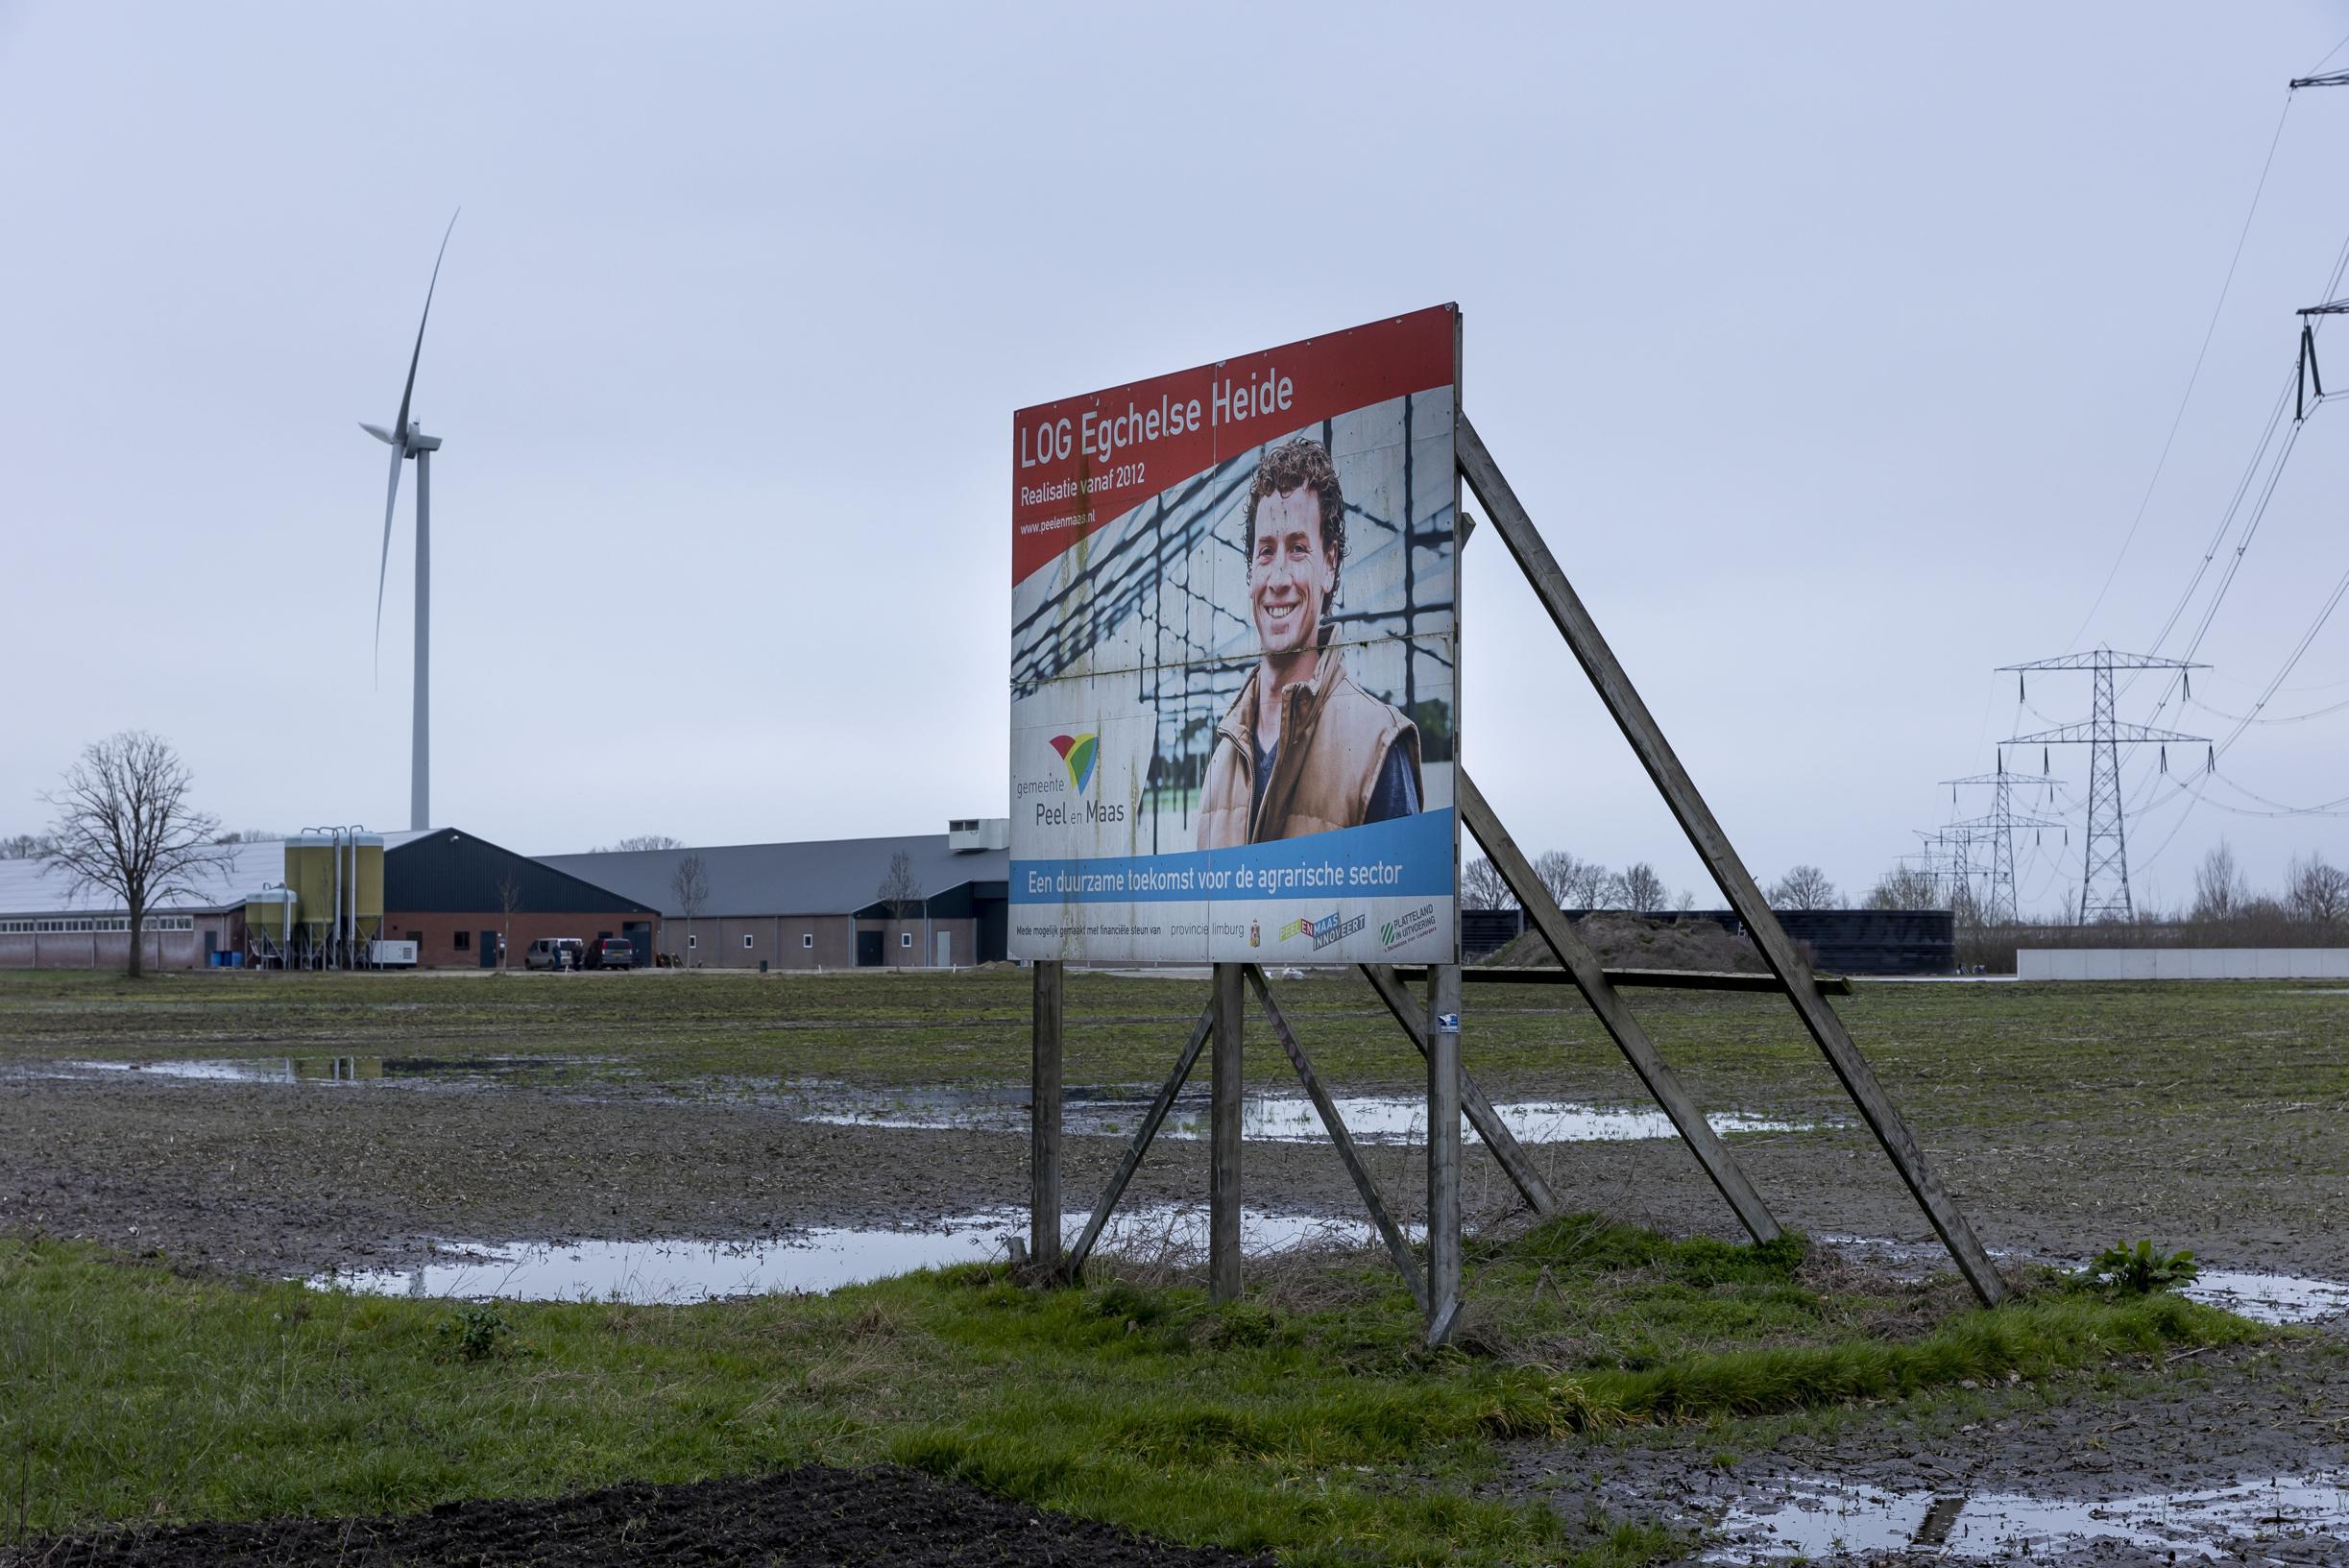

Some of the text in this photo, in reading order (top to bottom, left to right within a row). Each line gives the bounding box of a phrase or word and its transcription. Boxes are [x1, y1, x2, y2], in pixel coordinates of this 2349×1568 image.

[1022, 368, 1294, 469] LOG Egchelse Heide
[1021, 462, 1146, 507] Realisatie vanaf 2012
[1020, 509, 1096, 535] www.peelenmaas.nl
[1017, 777, 1065, 799] gemeente
[1036, 800, 1125, 826] Peel en Maas
[1029, 860, 1403, 895] Een duurzame toekomst voor de agrarische sector
[1279, 914, 1339, 940] PEEL EN MAAS
[1393, 904, 1434, 929] PLATTELAND
[1395, 915, 1436, 941] IN UITVOERING
[1016, 925, 1032, 936] Mede
[1033, 924, 1058, 938] mogelijk
[1059, 925, 1086, 938] gemaakt
[1086, 926, 1100, 936] met
[1130, 925, 1149, 936] steun
[1150, 926, 1162, 935] van
[1171, 922, 1245, 938] provincie limburg
[1314, 915, 1365, 950] INNOVEERT
